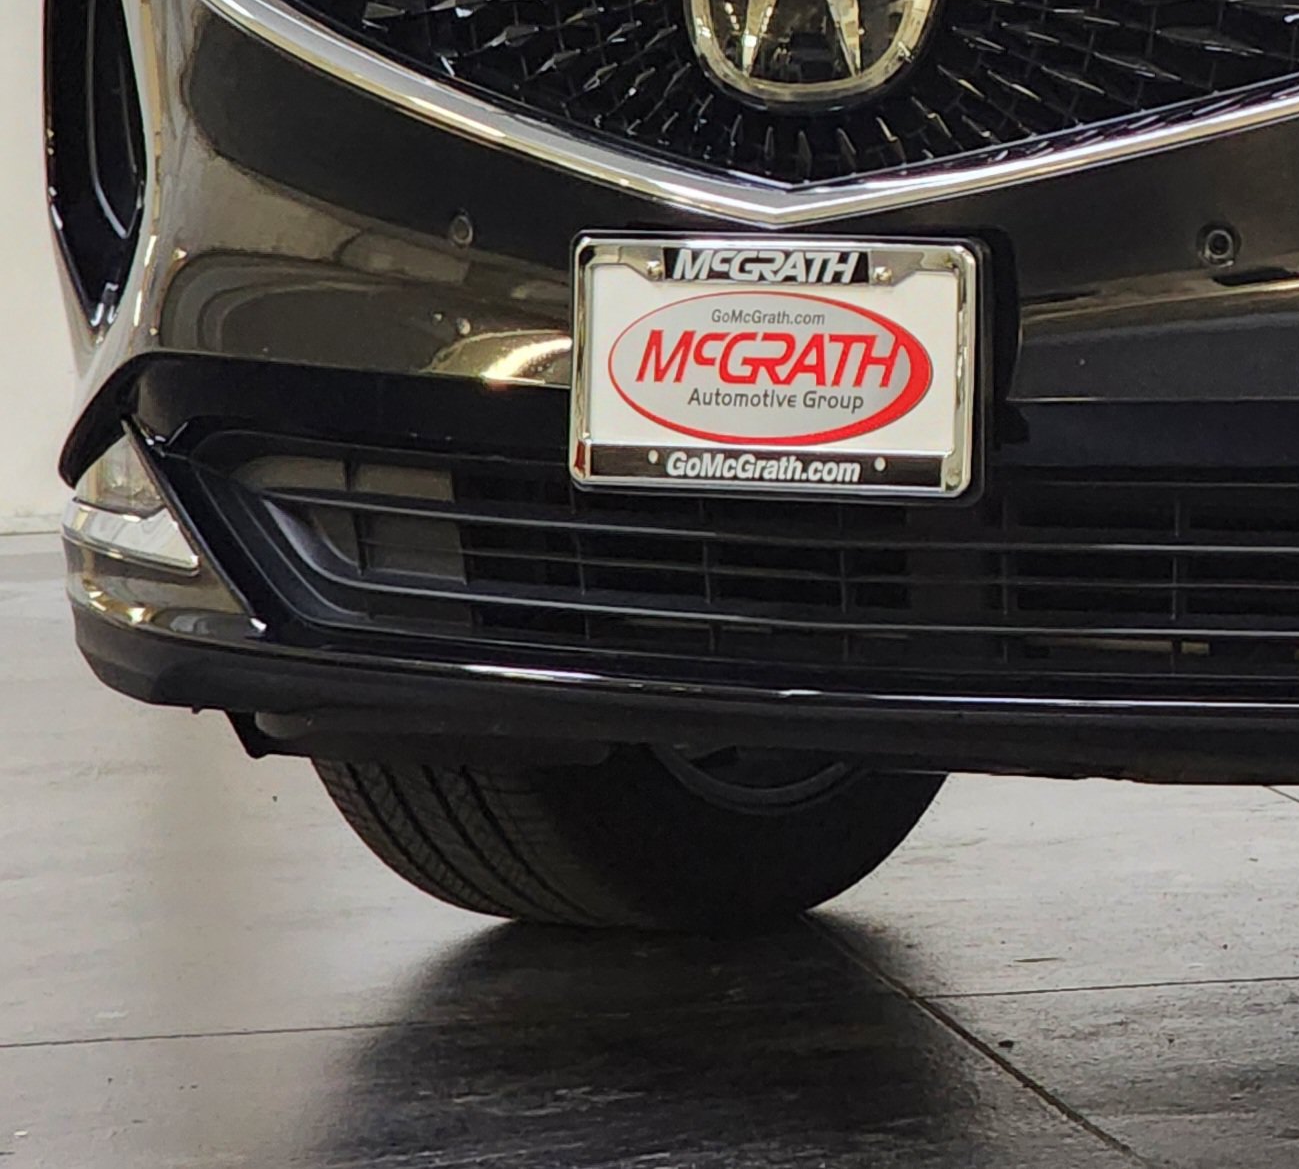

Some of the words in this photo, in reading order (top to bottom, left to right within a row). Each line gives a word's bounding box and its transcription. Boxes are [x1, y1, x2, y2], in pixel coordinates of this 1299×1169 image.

[711, 308, 825, 326] GoMcGrath.com
[687, 387, 797, 409] Automotive
[803, 389, 864, 414] Group
[665, 452, 862, 483] GoMcGrath.com
